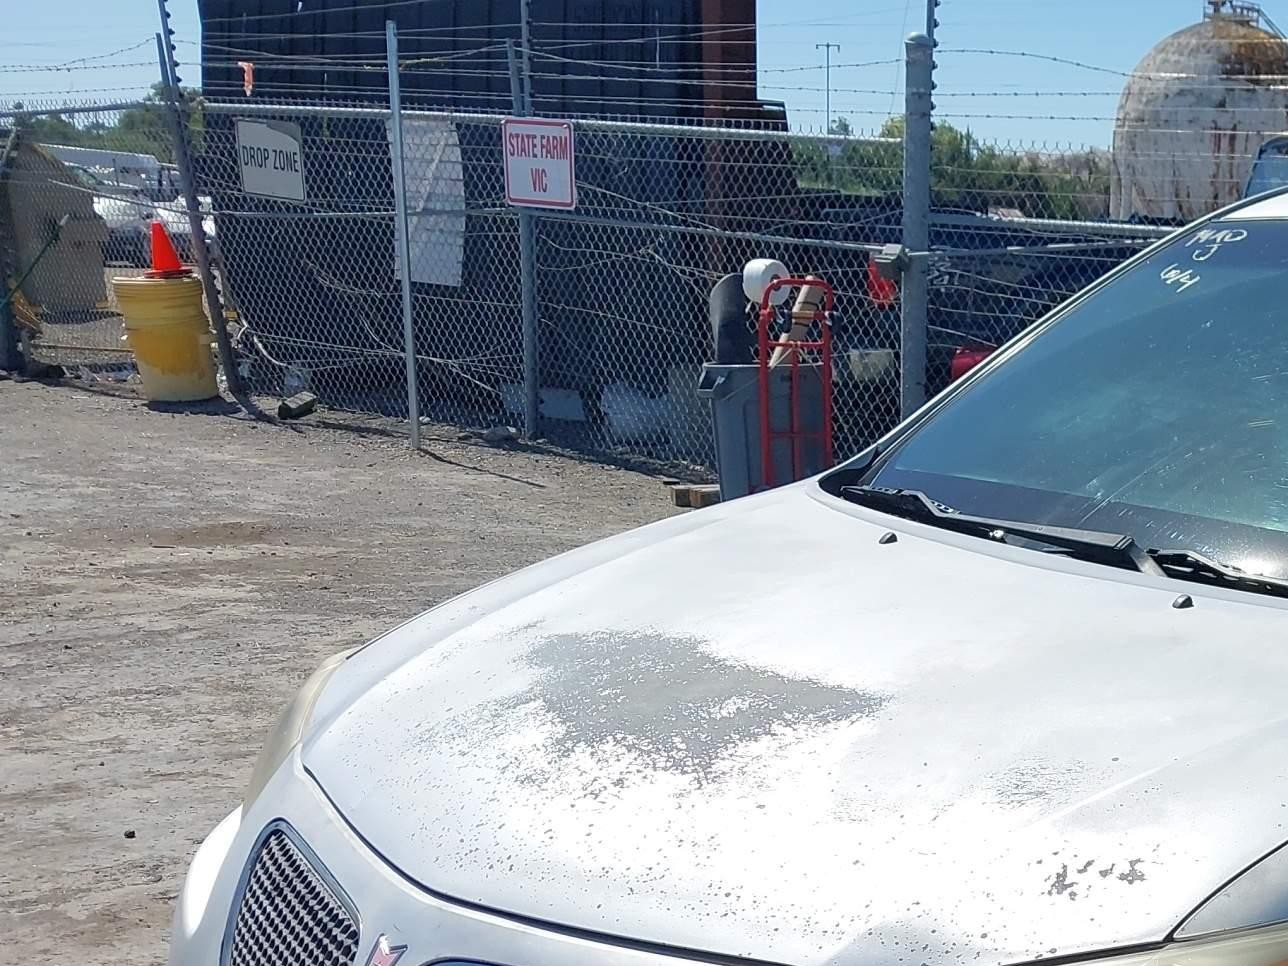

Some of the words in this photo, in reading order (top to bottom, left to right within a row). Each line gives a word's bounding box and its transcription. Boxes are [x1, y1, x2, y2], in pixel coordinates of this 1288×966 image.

[241, 145, 270, 169] DROP
[272, 148, 299, 173] ZONE
[508, 132, 537, 159] STATE
[540, 134, 569, 161] FARM
[530, 167, 548, 193] VIC
